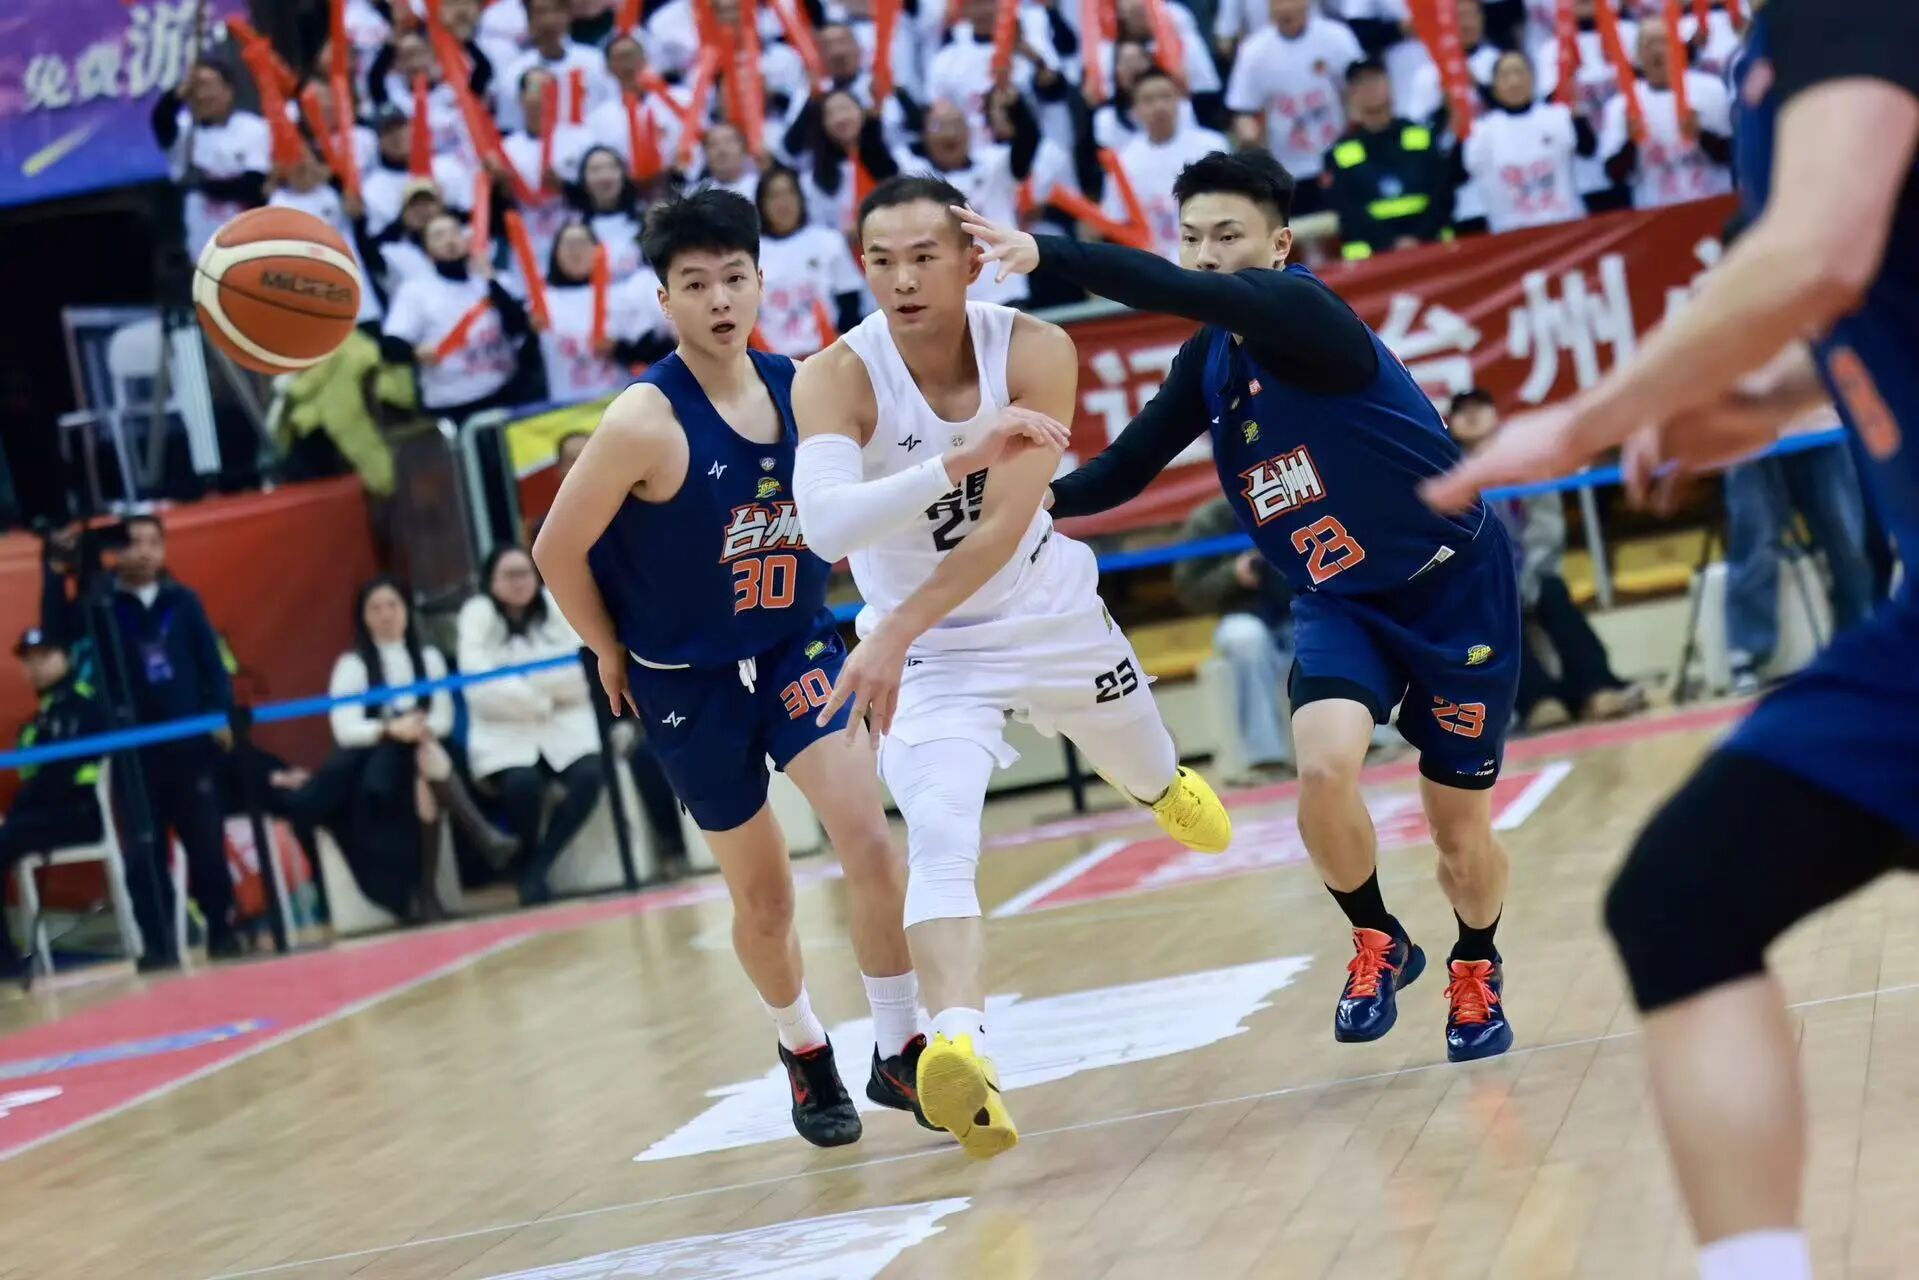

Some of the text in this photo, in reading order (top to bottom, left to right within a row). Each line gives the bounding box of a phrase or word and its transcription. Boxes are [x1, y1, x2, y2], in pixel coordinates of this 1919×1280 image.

[1238, 444, 1327, 527] 台州
[925, 505, 983, 552] 2
[1291, 515, 1365, 585] 23
[732, 554, 798, 616] 30
[780, 667, 834, 719] 30
[1094, 657, 1139, 704] 23
[1431, 695, 1486, 739] 23
